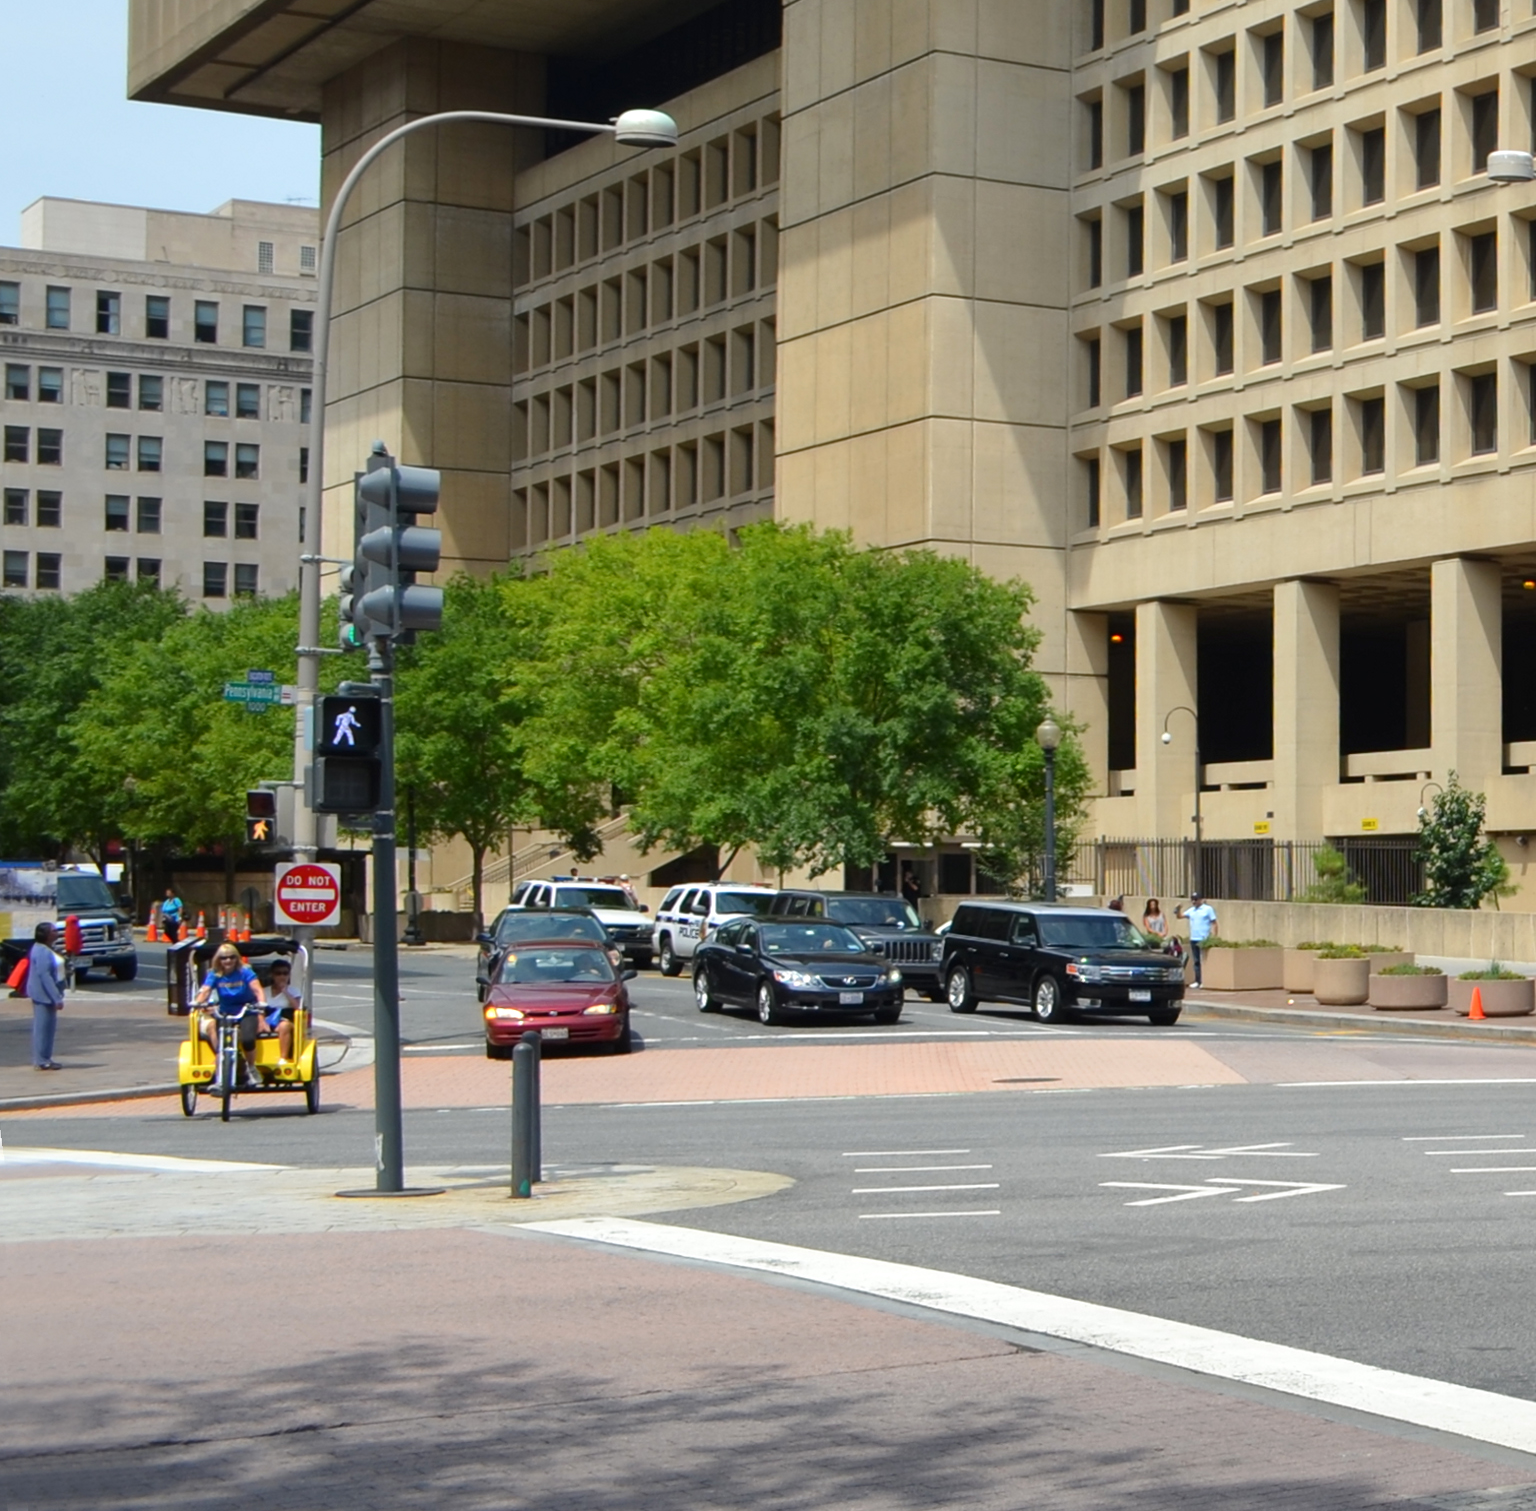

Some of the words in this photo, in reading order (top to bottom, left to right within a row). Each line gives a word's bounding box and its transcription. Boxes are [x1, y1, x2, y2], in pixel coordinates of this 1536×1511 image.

[225, 683, 272, 701] Pennsylvania
[286, 875, 302, 886] DO
[308, 875, 331, 886] NOT
[290, 902, 326, 913] ENTER
[679, 927, 700, 939] POLICE
